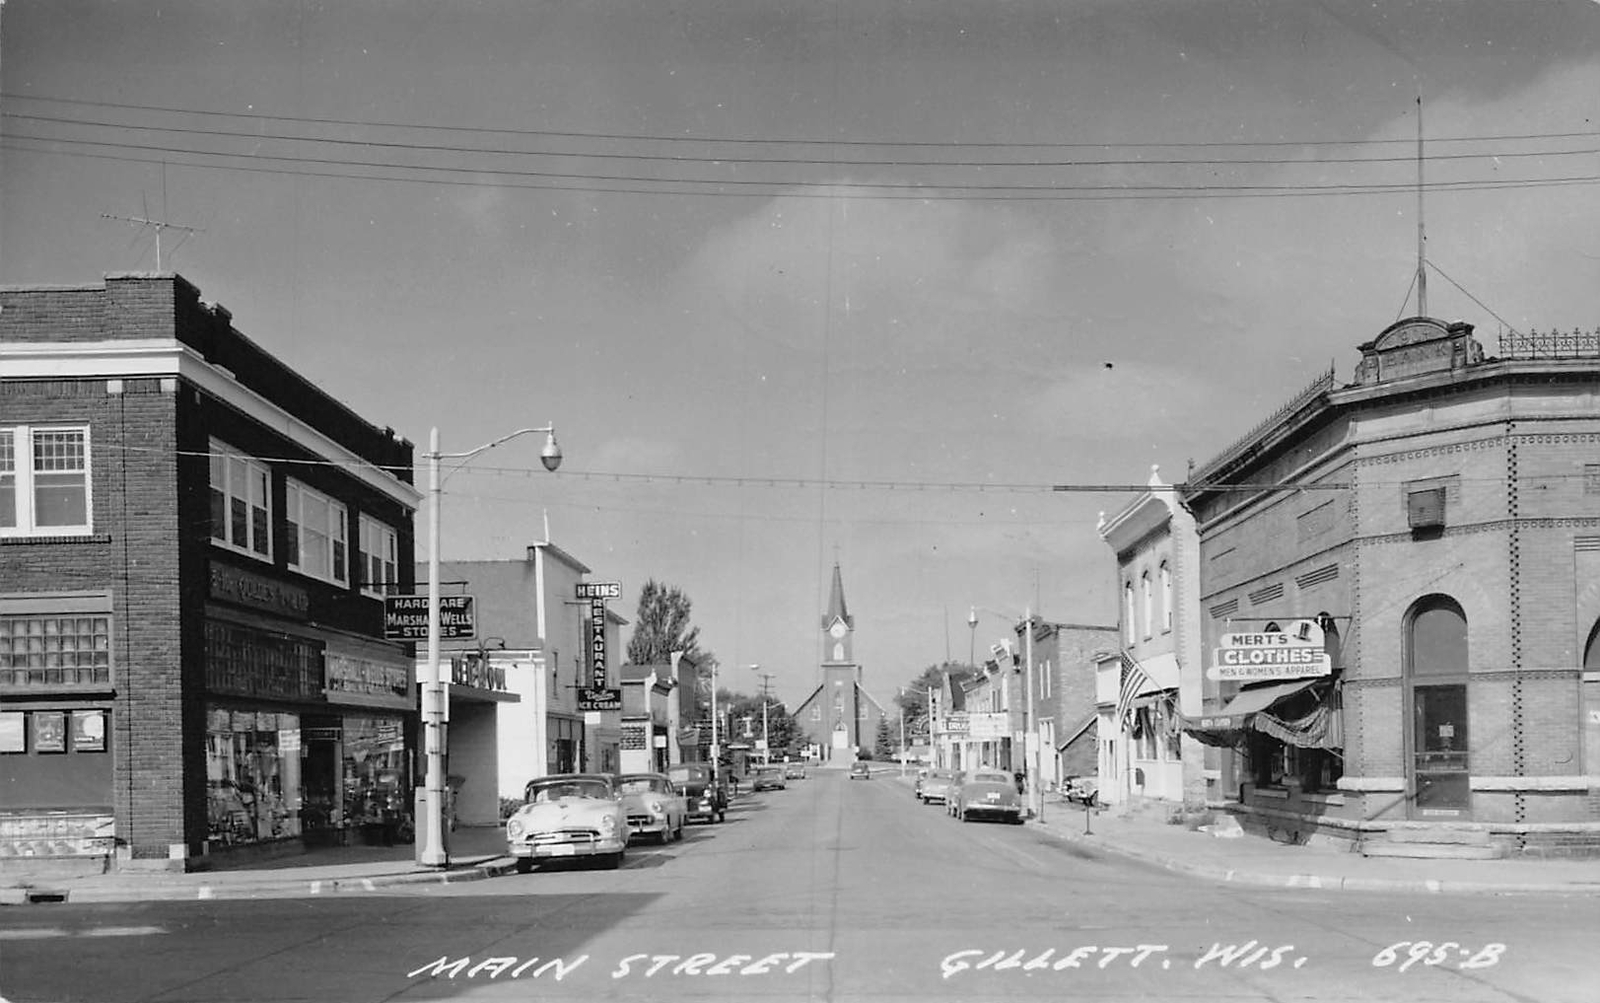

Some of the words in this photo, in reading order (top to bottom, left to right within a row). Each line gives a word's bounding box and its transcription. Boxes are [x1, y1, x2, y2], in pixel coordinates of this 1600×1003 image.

[577, 583, 619, 598] HEINS
[395, 599, 464, 608] HARDARE
[387, 613, 438, 626] MARSHA
[441, 612, 472, 625] WELLS
[403, 627, 457, 637] STOES
[593, 599, 604, 686] RESTAURANT
[1232, 635, 1288, 646] MERT'S
[1224, 649, 1313, 664] CLOTHES
